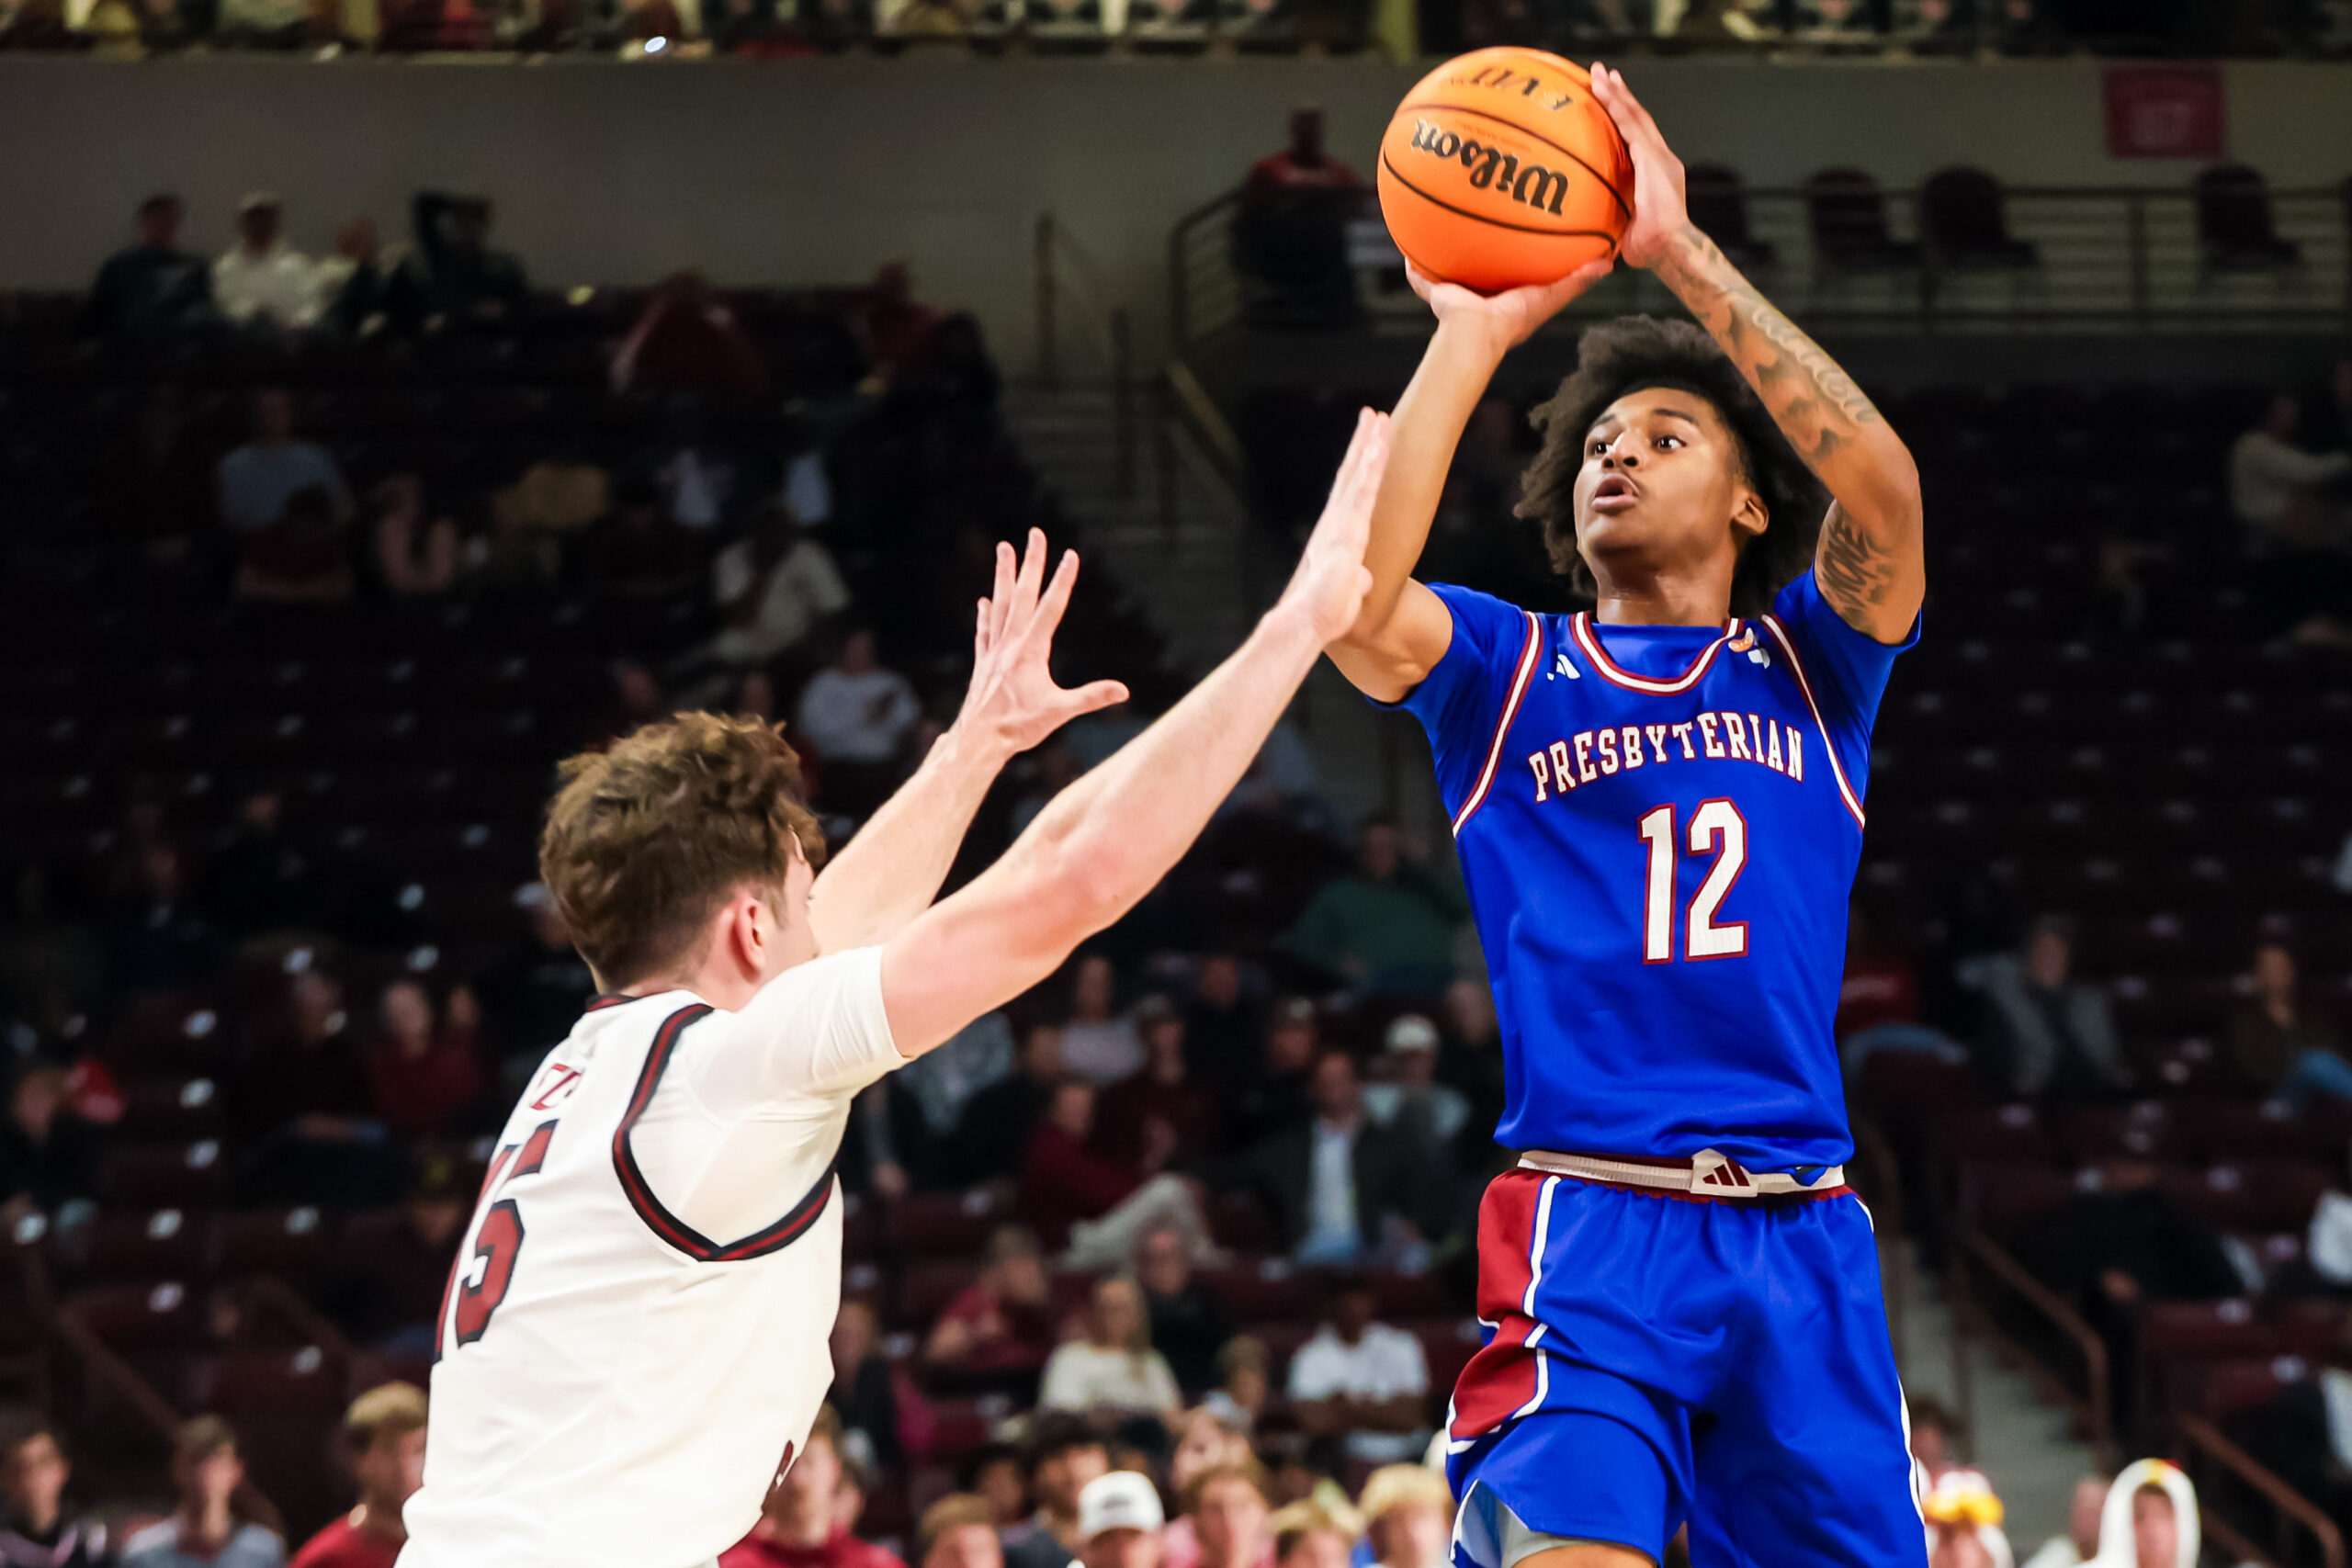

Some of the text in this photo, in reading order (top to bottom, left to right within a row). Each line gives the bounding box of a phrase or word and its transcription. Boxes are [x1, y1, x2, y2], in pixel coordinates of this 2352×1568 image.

[1409, 118, 1568, 216] Wilson
[1527, 709, 1804, 804] PRESBYTERIAN
[1637, 795, 1749, 965] 12
